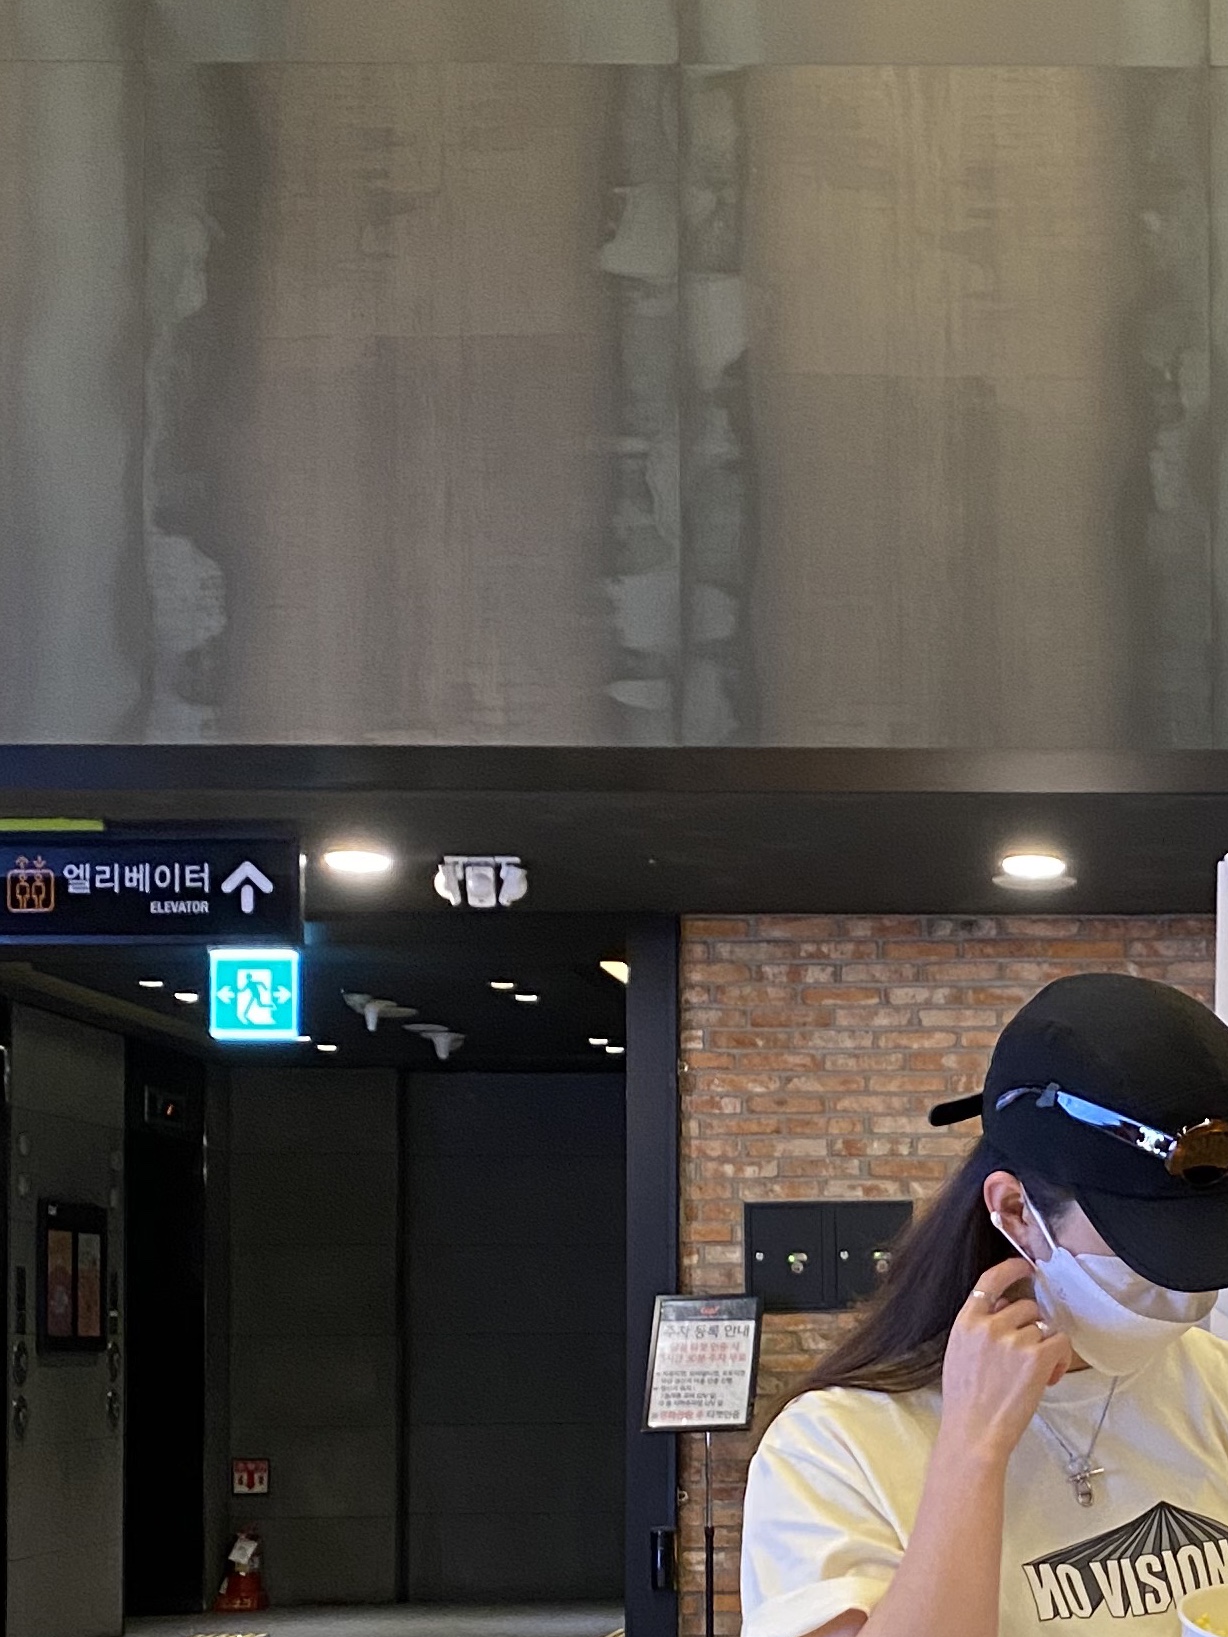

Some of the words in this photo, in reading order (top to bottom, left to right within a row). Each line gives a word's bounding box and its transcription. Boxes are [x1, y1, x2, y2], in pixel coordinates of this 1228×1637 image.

[62, 861, 210, 895] 엘리베이터
[150, 900, 209, 914] ELEVATOR
[724, 1323, 751, 1338] 안내
